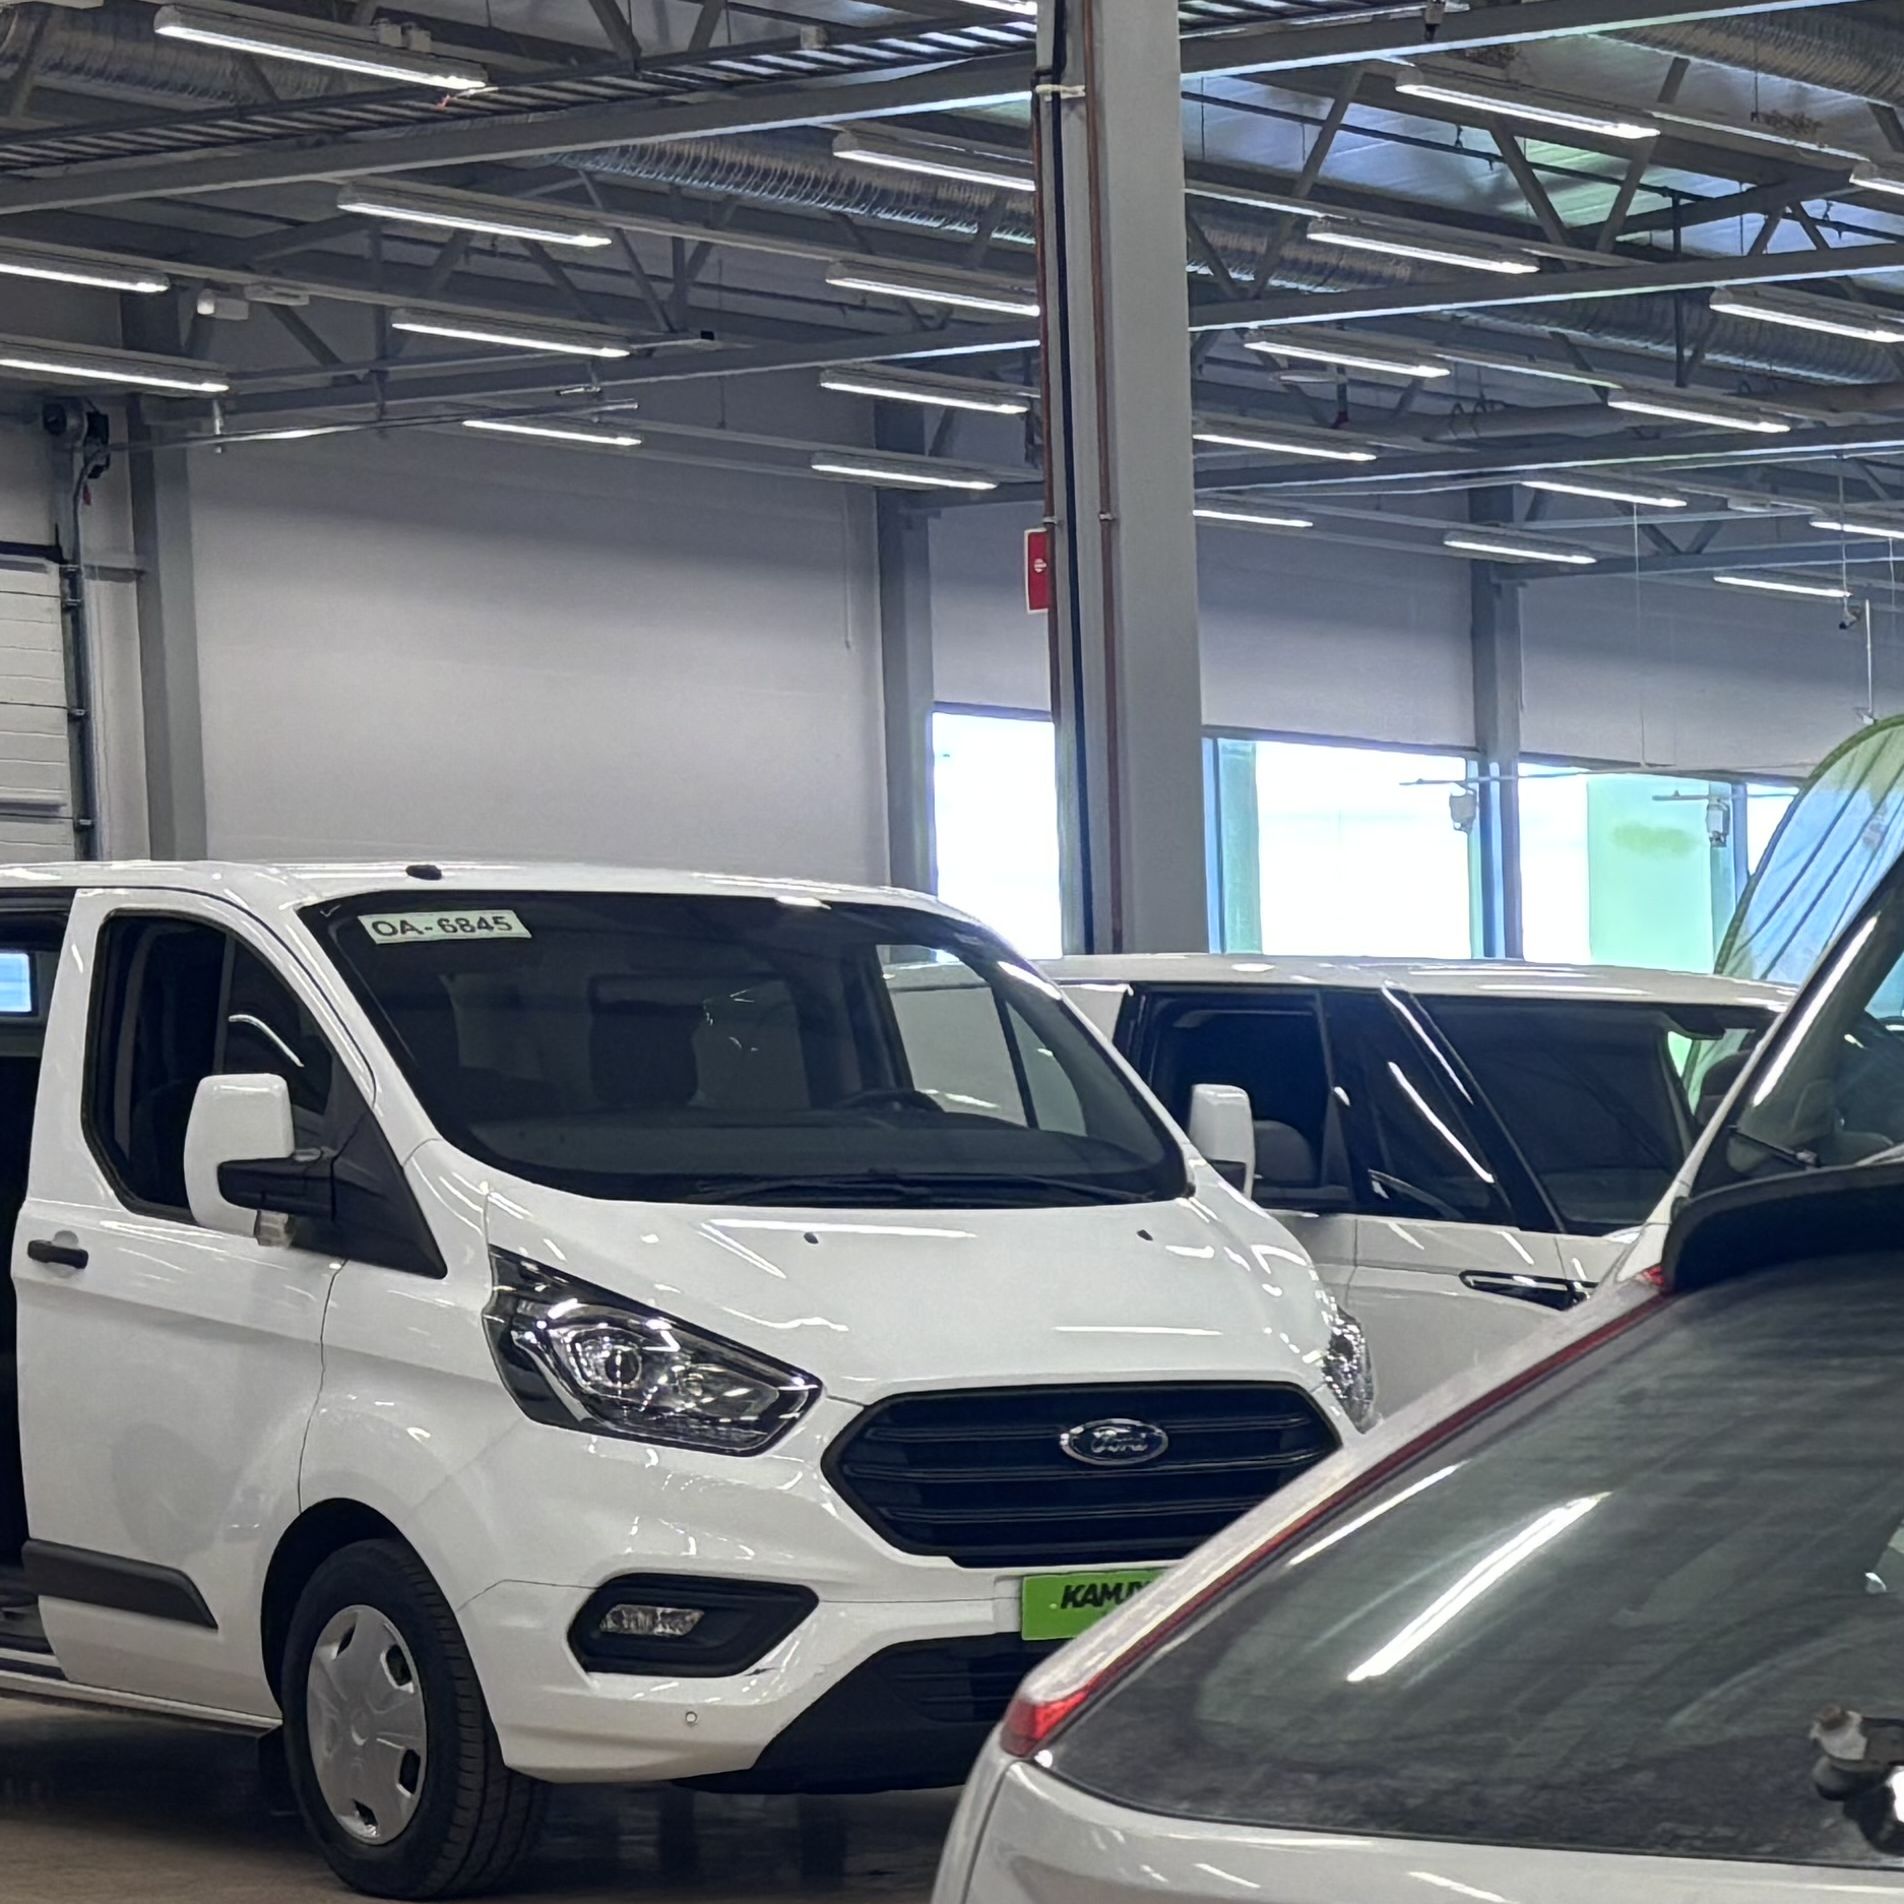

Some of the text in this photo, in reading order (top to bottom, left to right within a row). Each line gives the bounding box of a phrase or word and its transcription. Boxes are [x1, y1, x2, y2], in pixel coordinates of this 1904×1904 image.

[371, 916, 513, 936] OA-6845
[1091, 1426, 1148, 1453] Ford
[1061, 1581, 1151, 1609] KAMU
